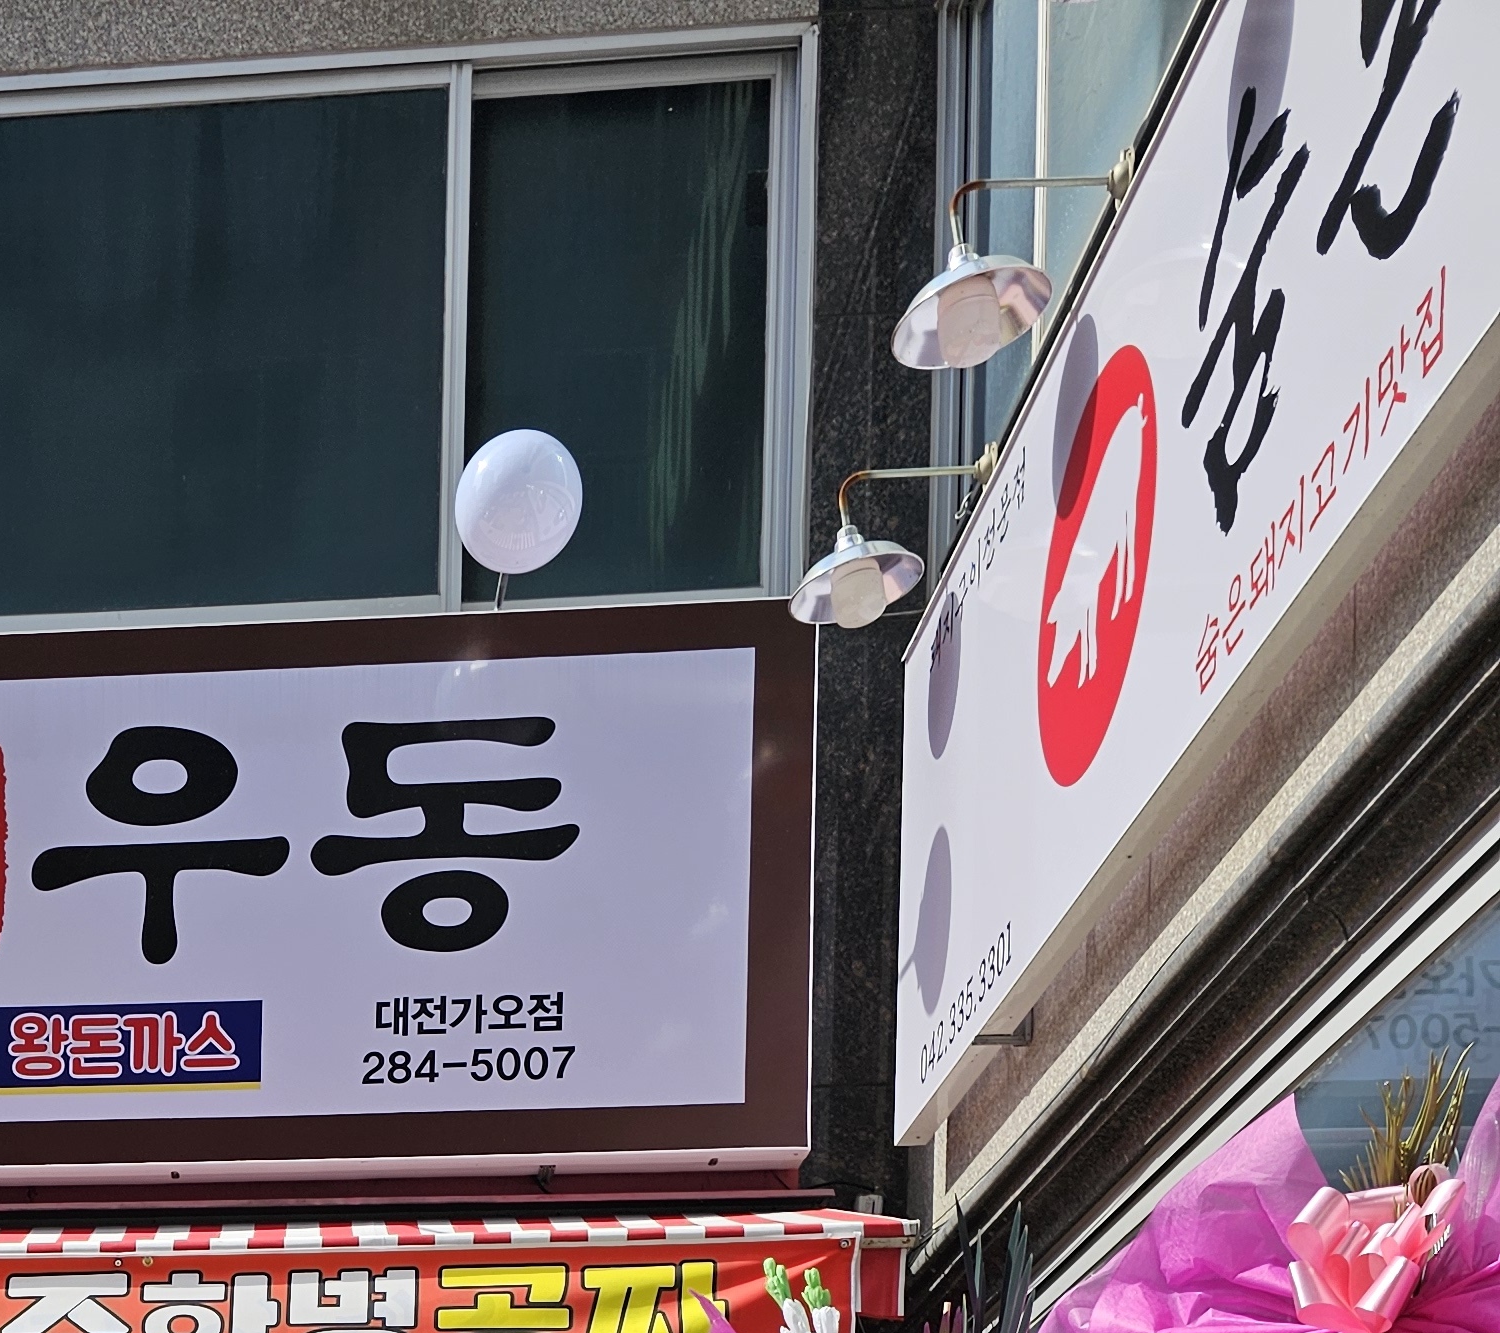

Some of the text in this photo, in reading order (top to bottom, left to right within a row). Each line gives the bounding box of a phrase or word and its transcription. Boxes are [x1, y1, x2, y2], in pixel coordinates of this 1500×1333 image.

[31, 717, 580, 965] 우동
[374, 991, 566, 1037] 대전가오점
[8, 1012, 241, 1080] 왕돈까스
[361, 1045, 577, 1087] 284-5007
